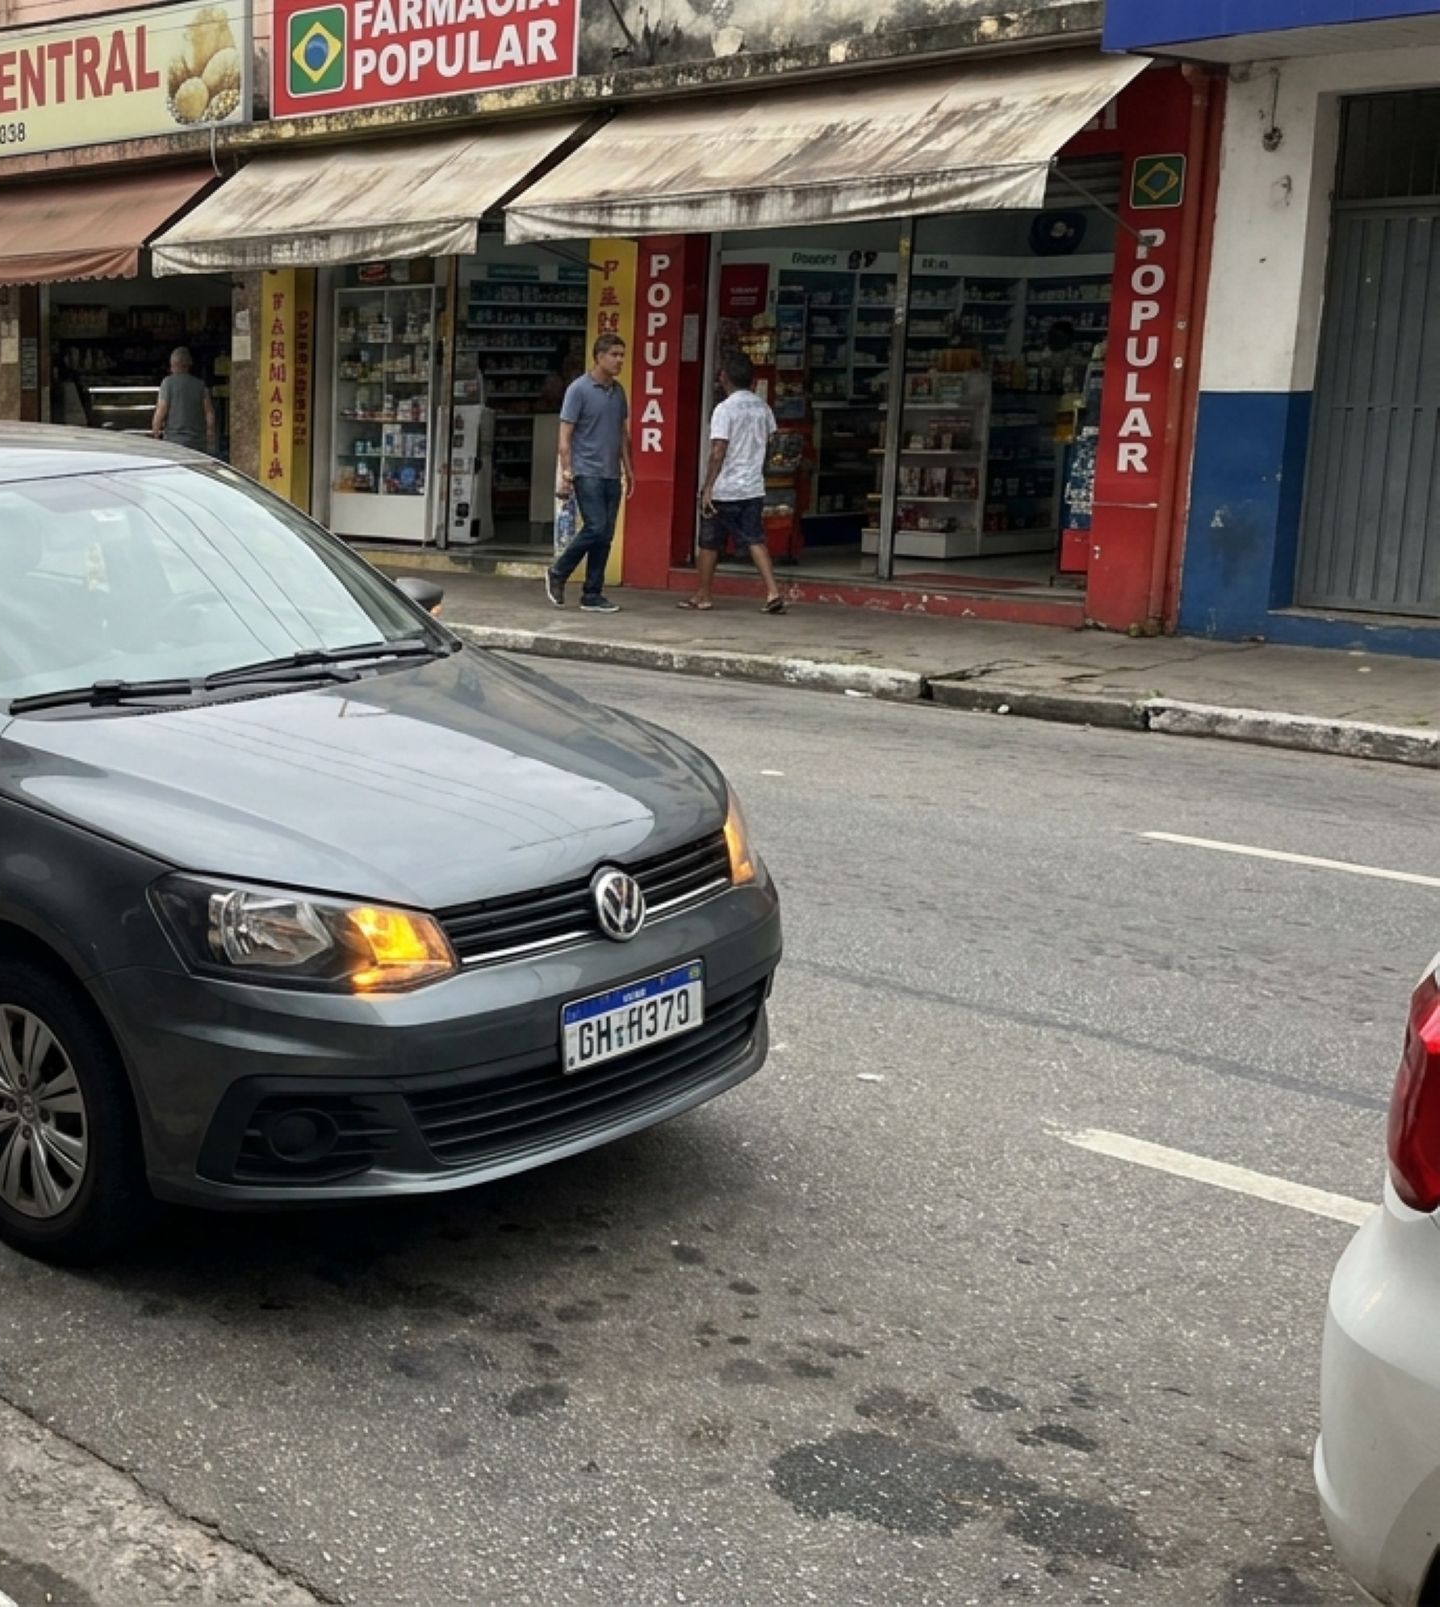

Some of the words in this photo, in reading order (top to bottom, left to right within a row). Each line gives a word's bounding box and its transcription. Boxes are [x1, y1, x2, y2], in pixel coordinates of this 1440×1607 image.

[353, 18, 558, 90] POPULAR
[354, 0, 559, 40] FARMA
[641, 254, 671, 452] POPULAR
[1116, 228, 1166, 472] POPULAR
